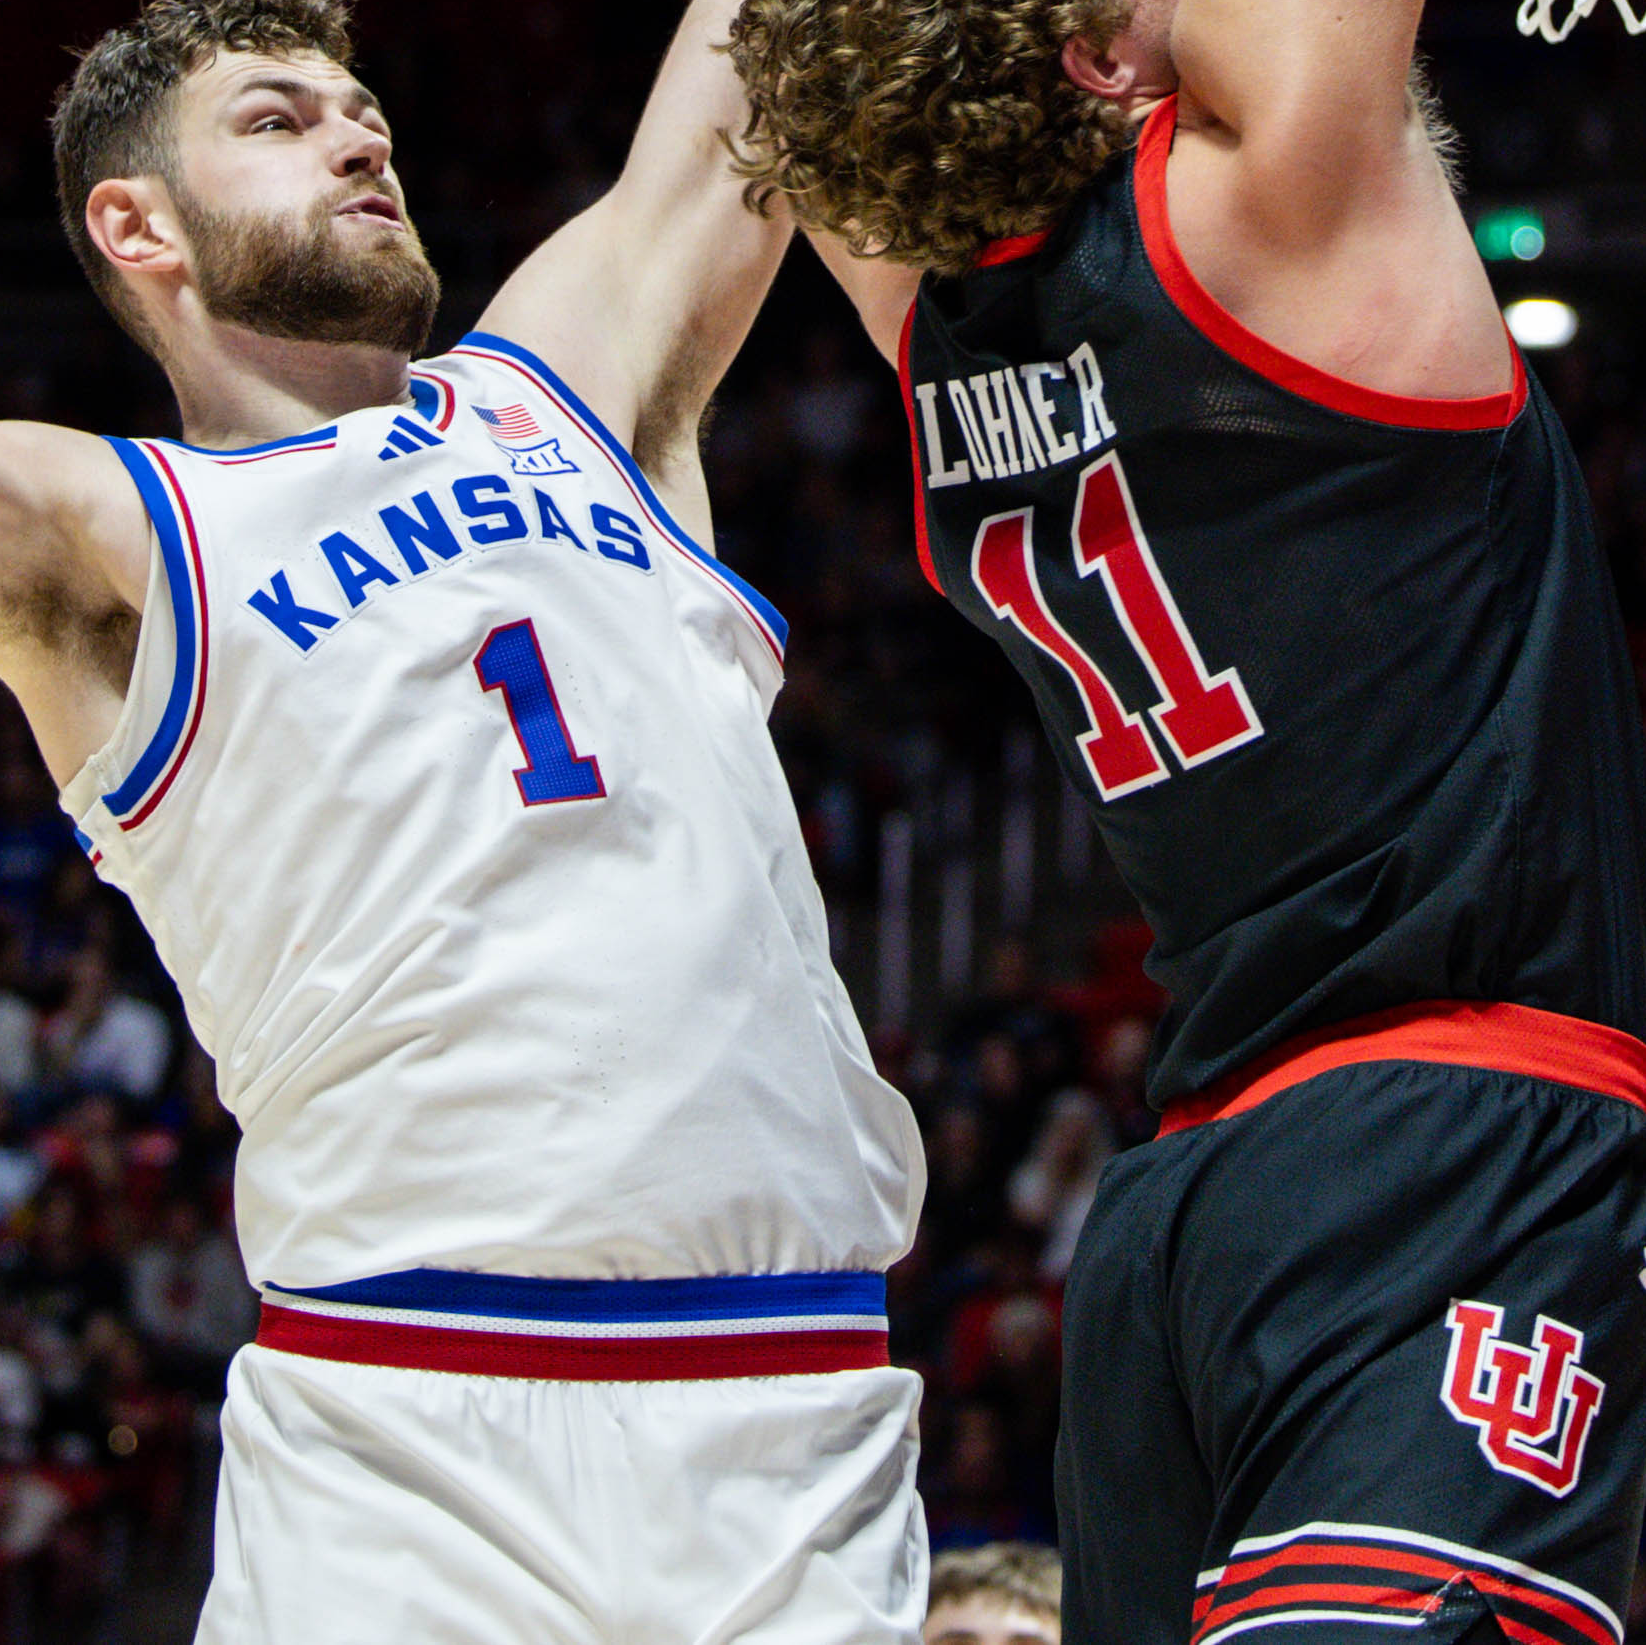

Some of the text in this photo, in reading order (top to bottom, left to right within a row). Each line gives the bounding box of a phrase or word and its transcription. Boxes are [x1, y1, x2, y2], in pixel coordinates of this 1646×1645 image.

[244, 473, 654, 657] KANSAS
[970, 448, 1266, 803] 11
[472, 616, 607, 808] 1
